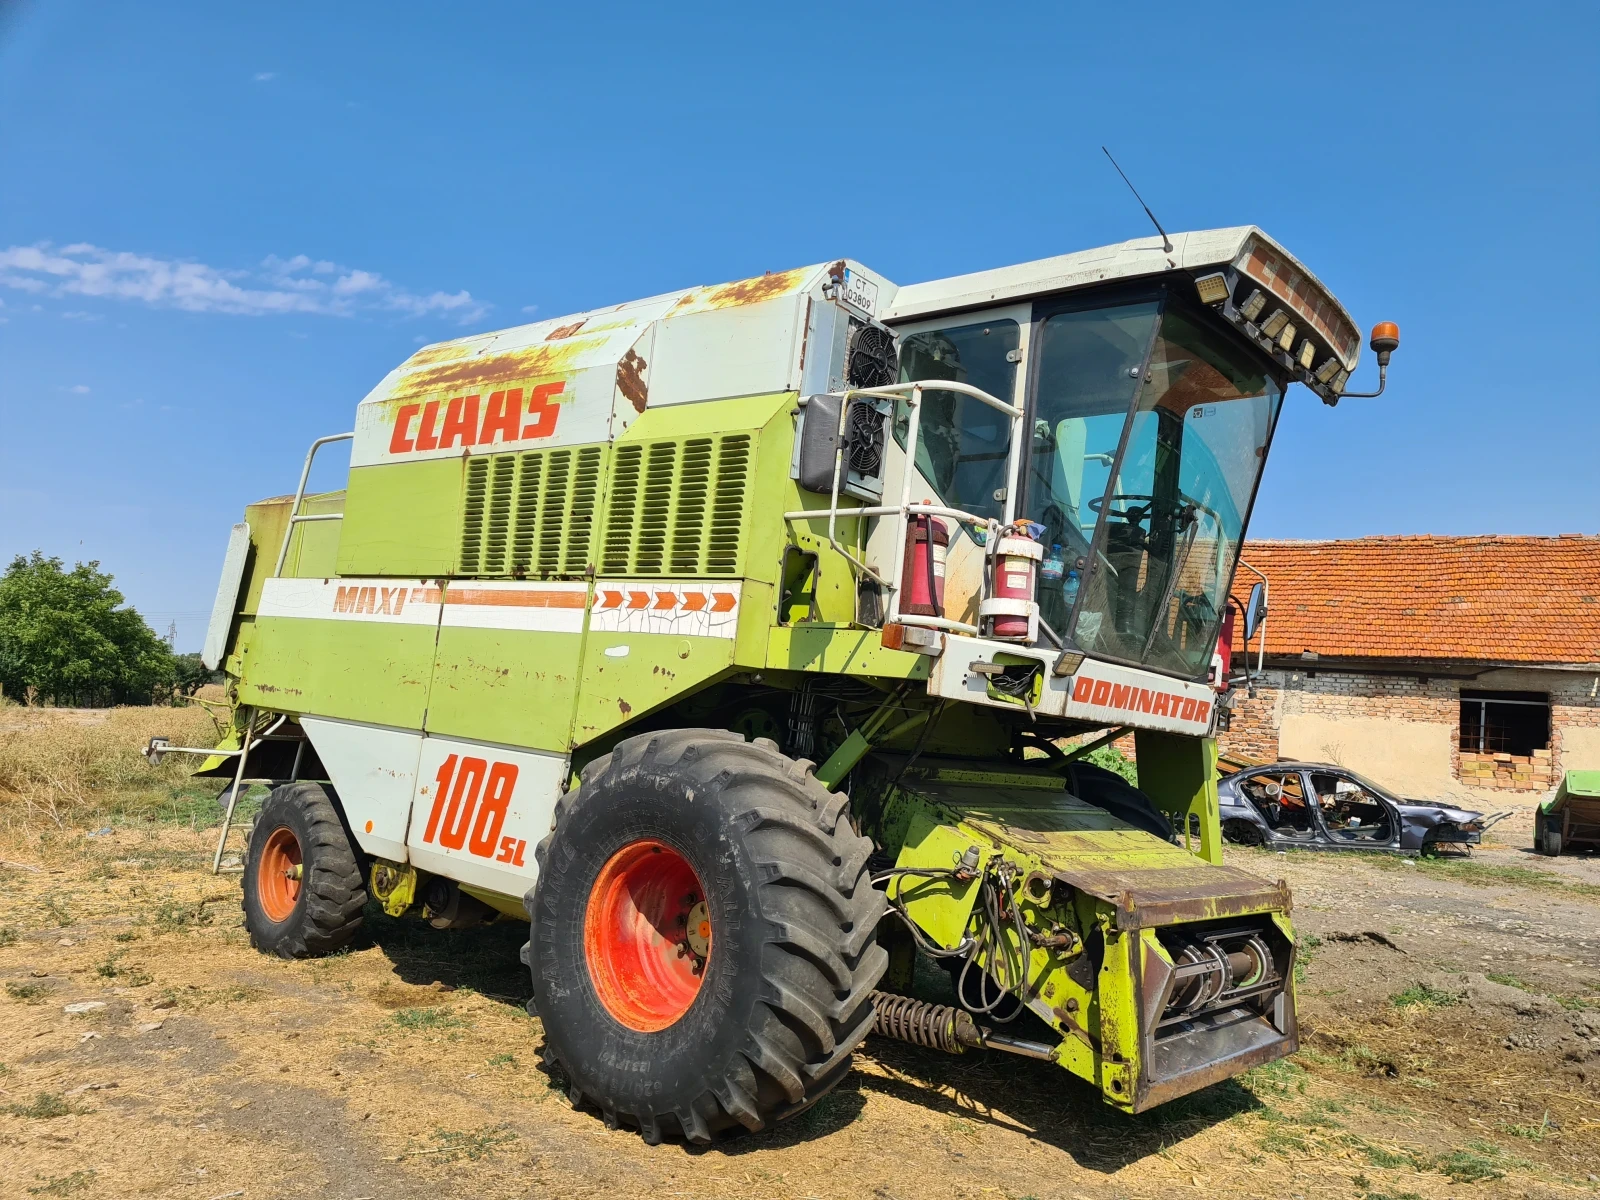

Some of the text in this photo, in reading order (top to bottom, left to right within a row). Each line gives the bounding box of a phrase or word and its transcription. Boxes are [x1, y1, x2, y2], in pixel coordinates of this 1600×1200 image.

[848, 289, 871, 310] 03809
[856, 279, 867, 292] CT
[389, 381, 566, 454] CLAAS
[333, 586, 408, 615] MAXI
[1072, 676, 1210, 723] DOMINATOR
[423, 754, 527, 867] 108 SL
[540, 843, 576, 983] ALLIANCE
